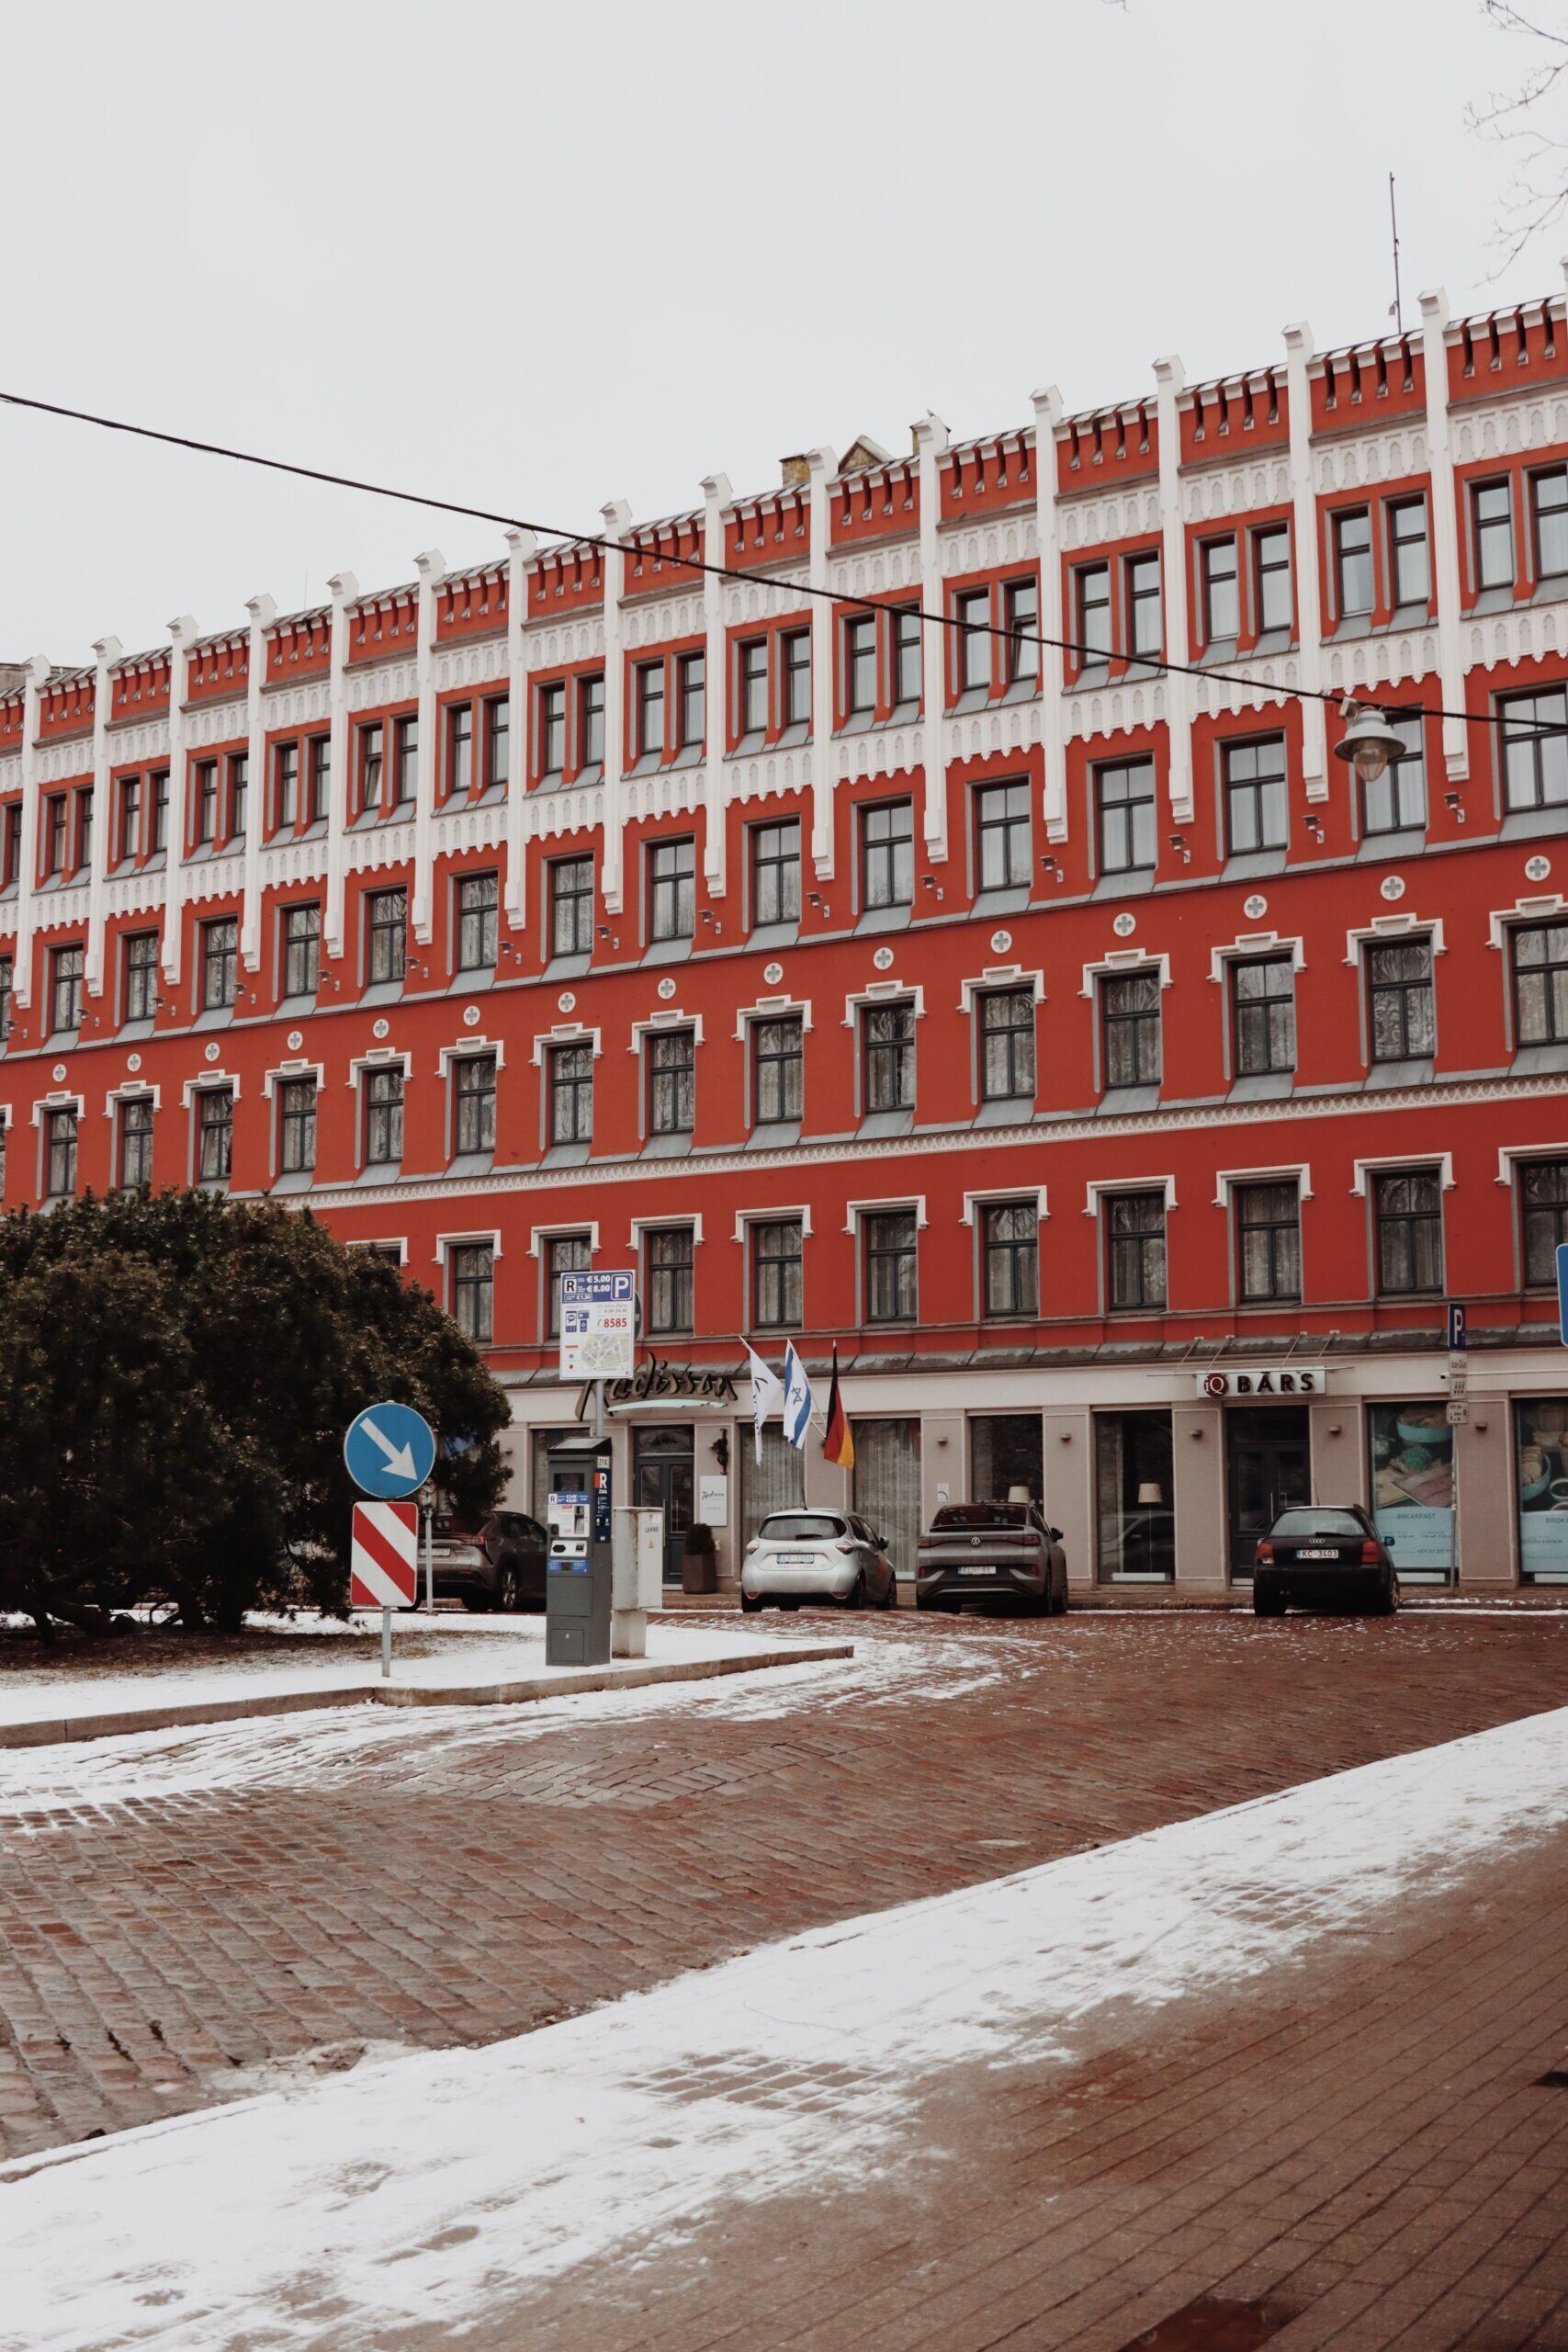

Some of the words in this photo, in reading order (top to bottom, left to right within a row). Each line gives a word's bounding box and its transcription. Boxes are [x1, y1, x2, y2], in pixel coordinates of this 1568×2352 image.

[566, 1280, 575, 1292] R
[615, 1277, 629, 1298] P
[604, 1317, 627, 1328] 8585
[1454, 1309, 1463, 1345] P
